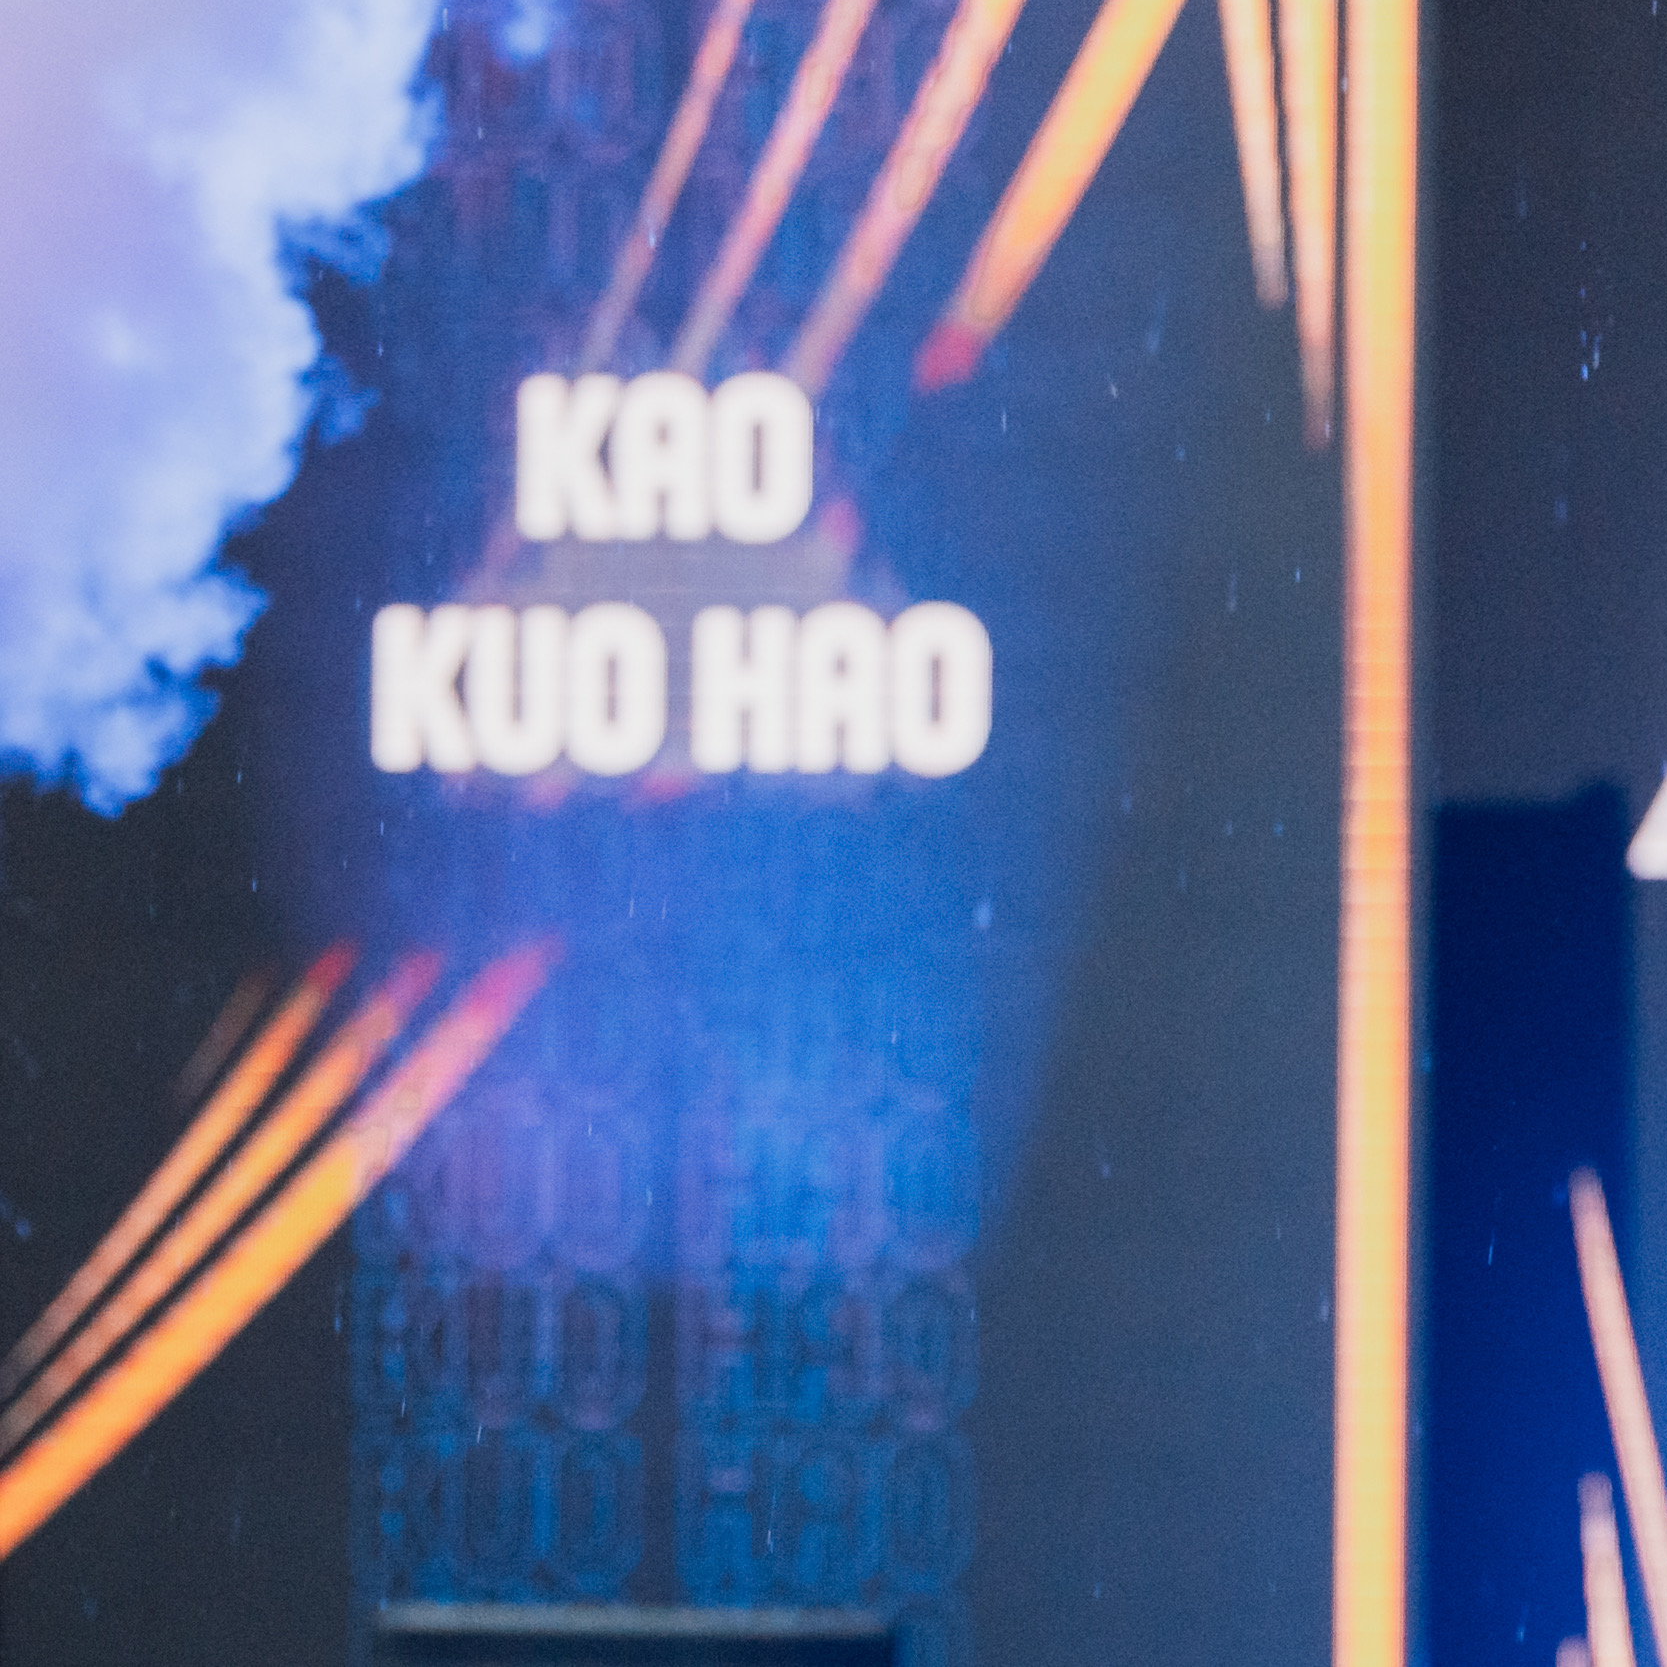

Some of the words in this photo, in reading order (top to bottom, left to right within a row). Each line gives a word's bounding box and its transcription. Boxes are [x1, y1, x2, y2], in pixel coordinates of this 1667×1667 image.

[515, 370, 814, 543] KAO
[371, 600, 666, 777] KUO
[690, 600, 993, 778] HAO
